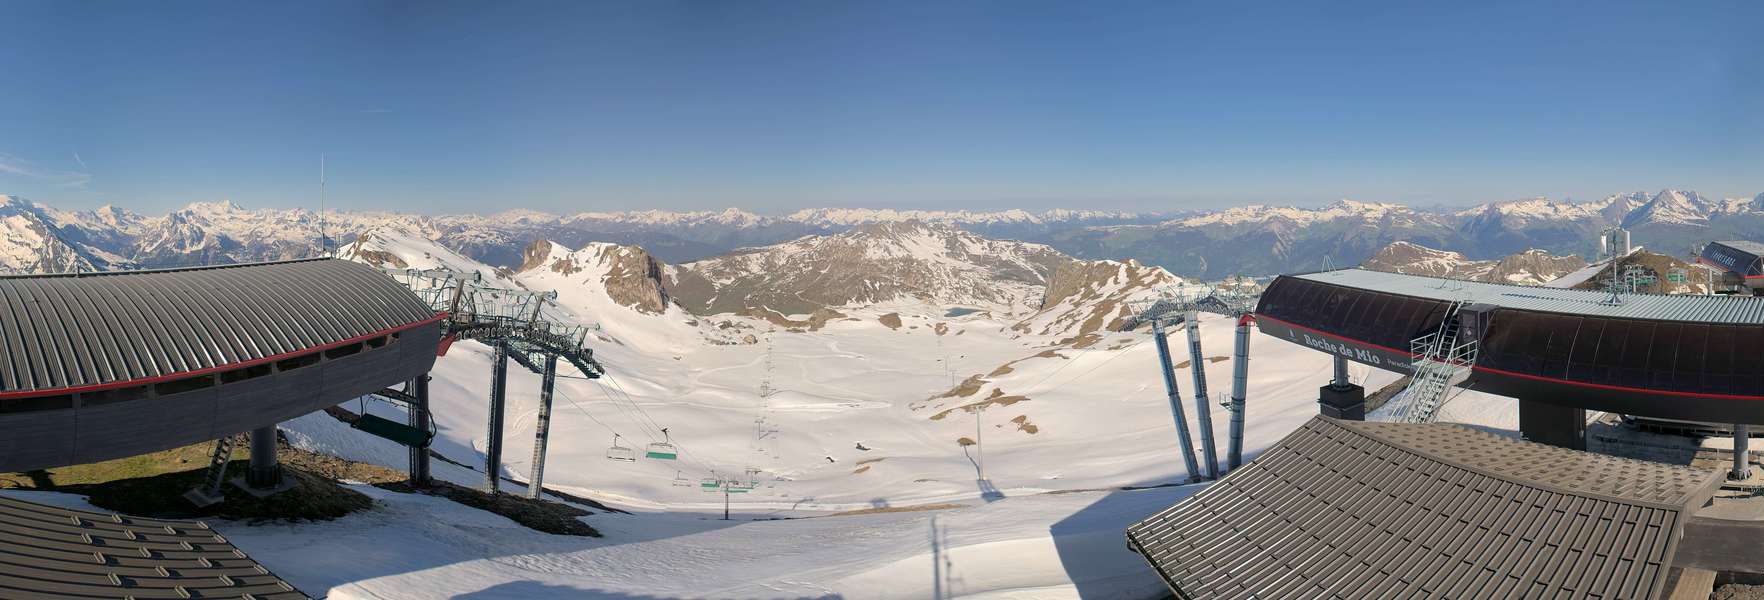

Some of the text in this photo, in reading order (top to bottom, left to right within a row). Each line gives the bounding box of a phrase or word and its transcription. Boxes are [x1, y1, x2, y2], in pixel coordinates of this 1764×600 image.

[1303, 334, 1381, 364] Roche de Mio
